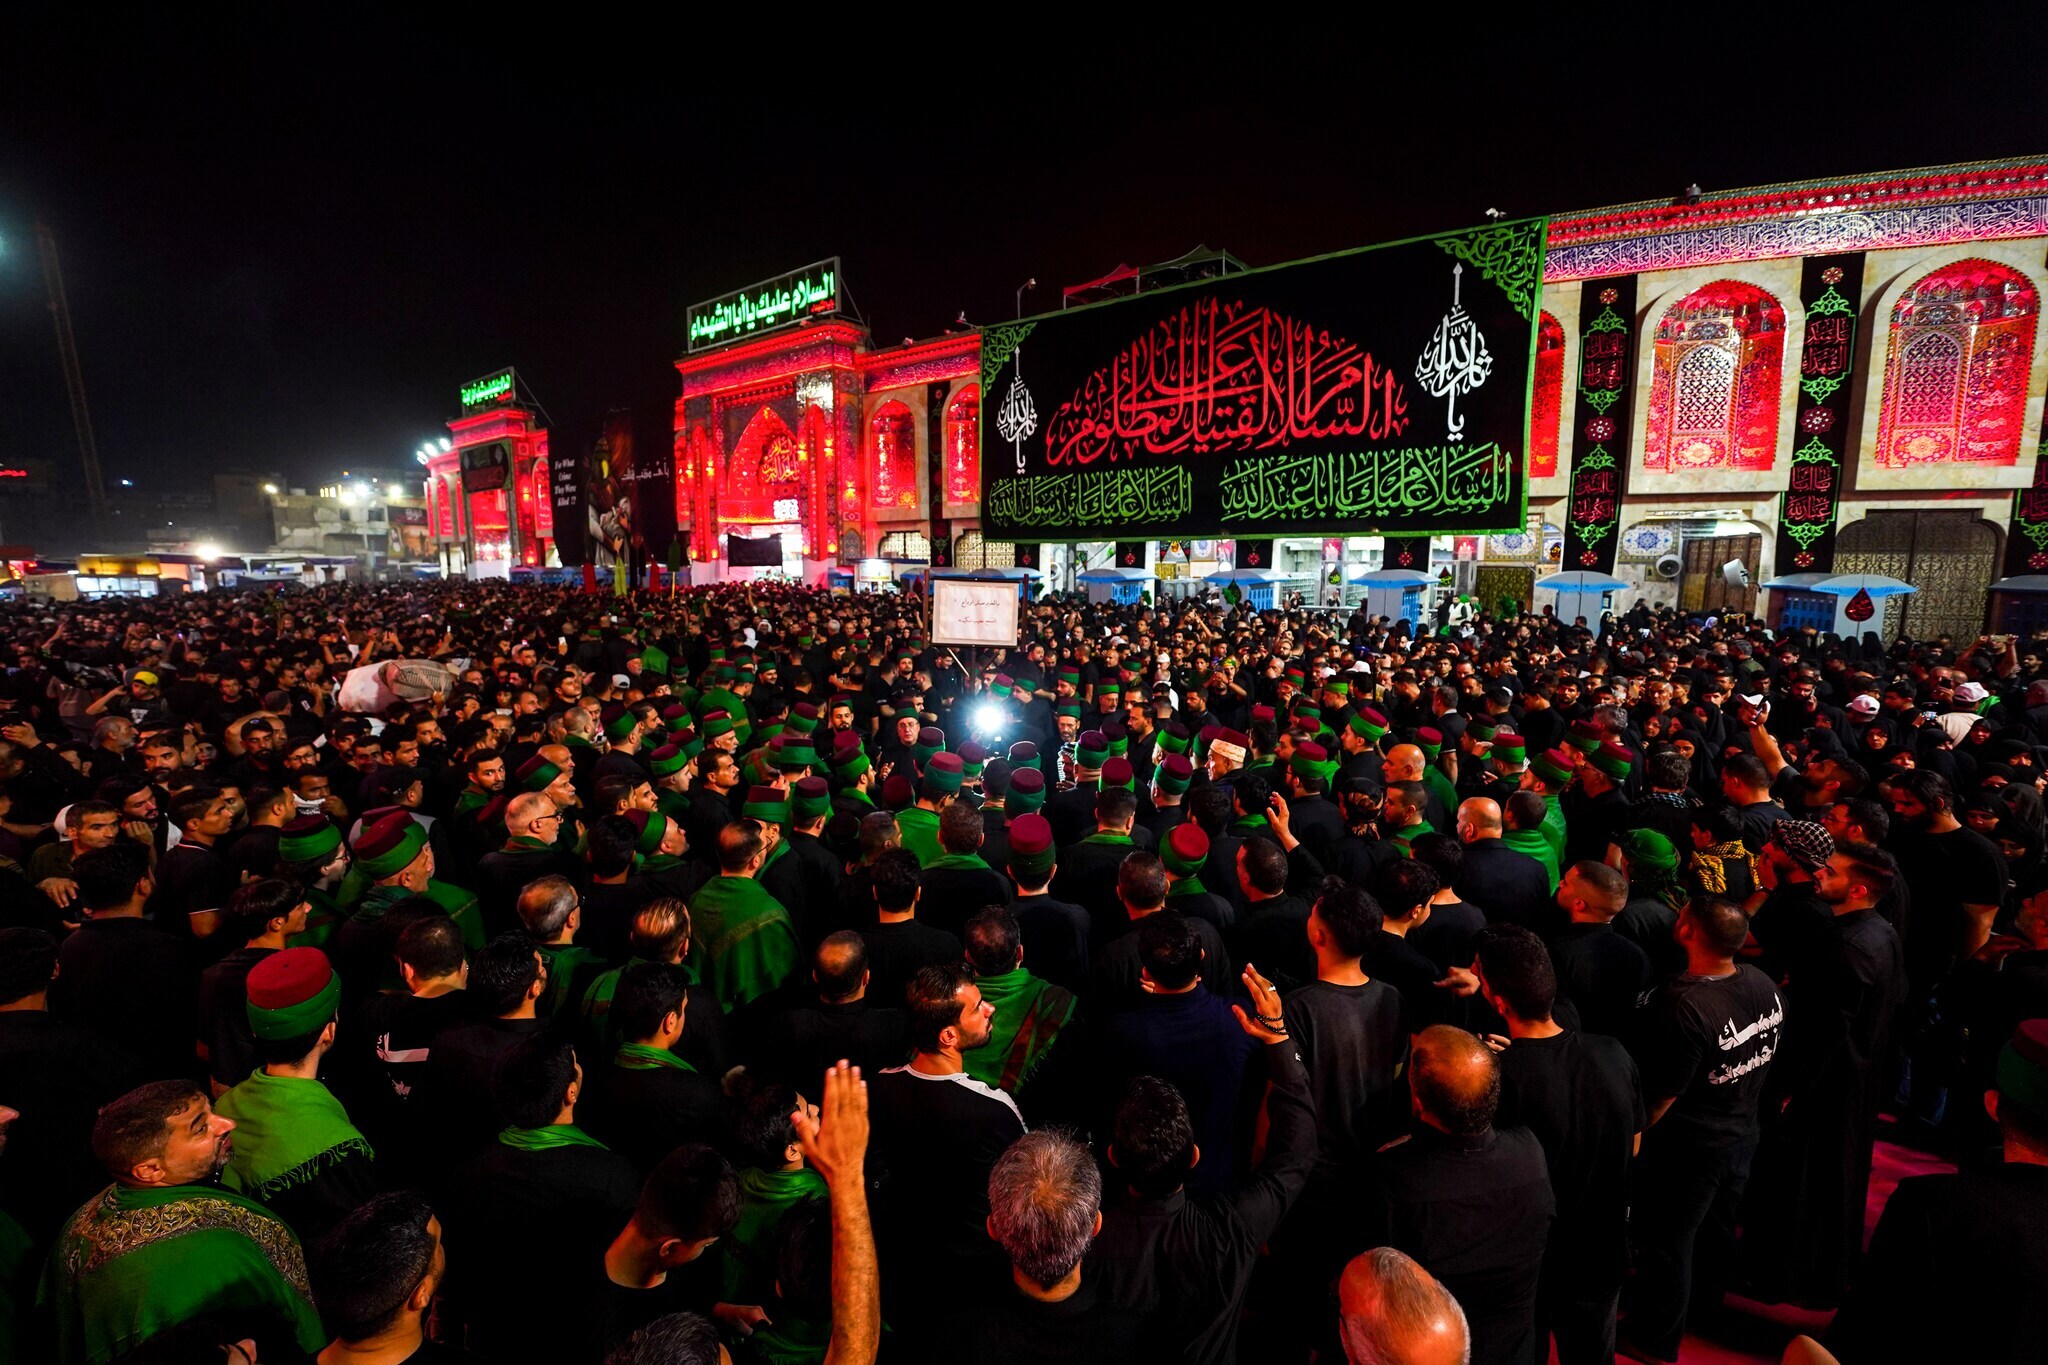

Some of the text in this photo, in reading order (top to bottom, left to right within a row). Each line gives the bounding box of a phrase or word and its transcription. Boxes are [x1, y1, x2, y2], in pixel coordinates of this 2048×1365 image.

[756, 288, 791, 323] عليك
[792, 271, 834, 315] السلام
[690, 302, 732, 341] الشهداء
[1046, 299, 1216, 466] المظلوم
[1252, 316, 1402, 450] السلام
[989, 478, 1018, 518] الله
[1077, 471, 1140, 524] عليك
[1106, 466, 1192, 523] السلام
[1220, 459, 1263, 511] الله
[1335, 450, 1432, 517] عليك
[1380, 443, 1513, 514] السلام
[1718, 992, 1783, 1051] لبيك
